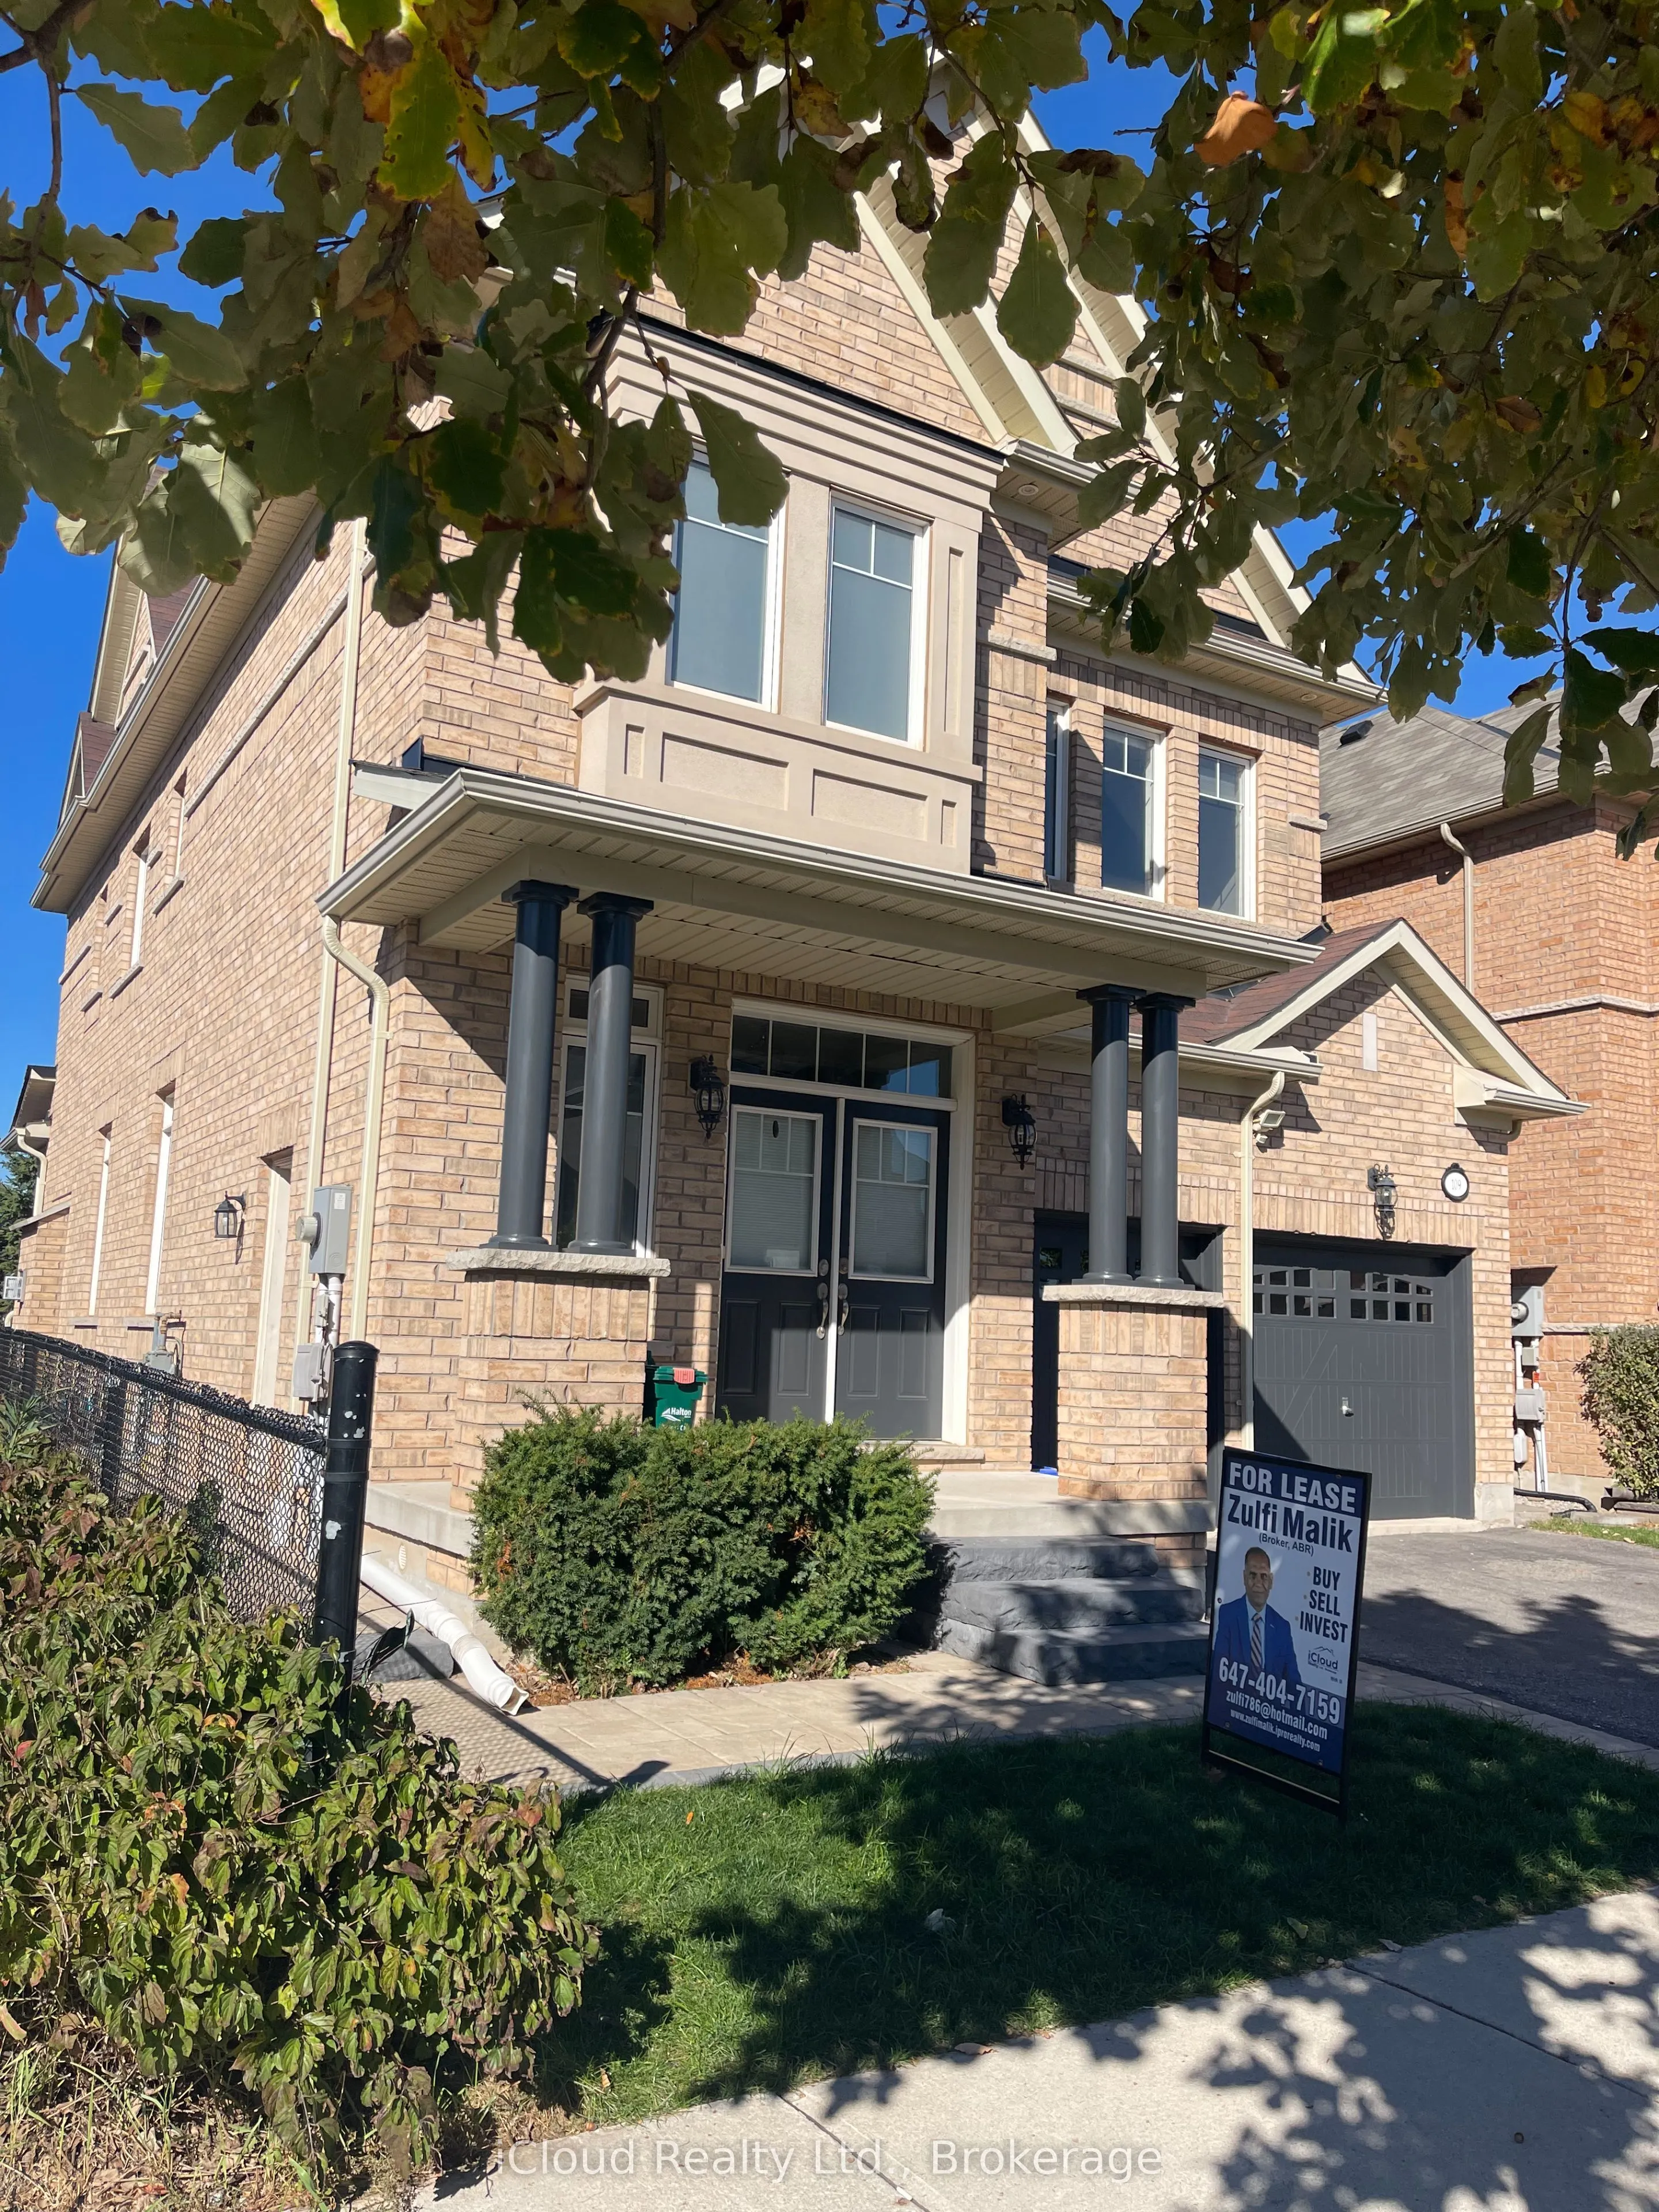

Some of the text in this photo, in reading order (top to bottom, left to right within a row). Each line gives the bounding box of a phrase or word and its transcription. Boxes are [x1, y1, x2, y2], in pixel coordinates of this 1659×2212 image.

[1451, 1179, 1461, 1190] 109
[671, 1407, 692, 1416] Halton
[1229, 1461, 1356, 1514] FOR LEASE
[1228, 1493, 1353, 1553] Zulfi Malik
[1259, 1534, 1314, 1556] (Broker, ABR)
[1313, 1566, 1340, 1591] BUY
[1309, 1590, 1340, 1616] SELL
[1300, 1611, 1349, 1643] INVEST
[1308, 1650, 1338, 1669] iCloud
[1219, 1657, 1341, 1725] 647-404-7159
[1226, 1690, 1327, 1740] zulfi786@hotmail.com
[1230, 1709, 1320, 1752] www.zulfimalik.iprorealty.com
